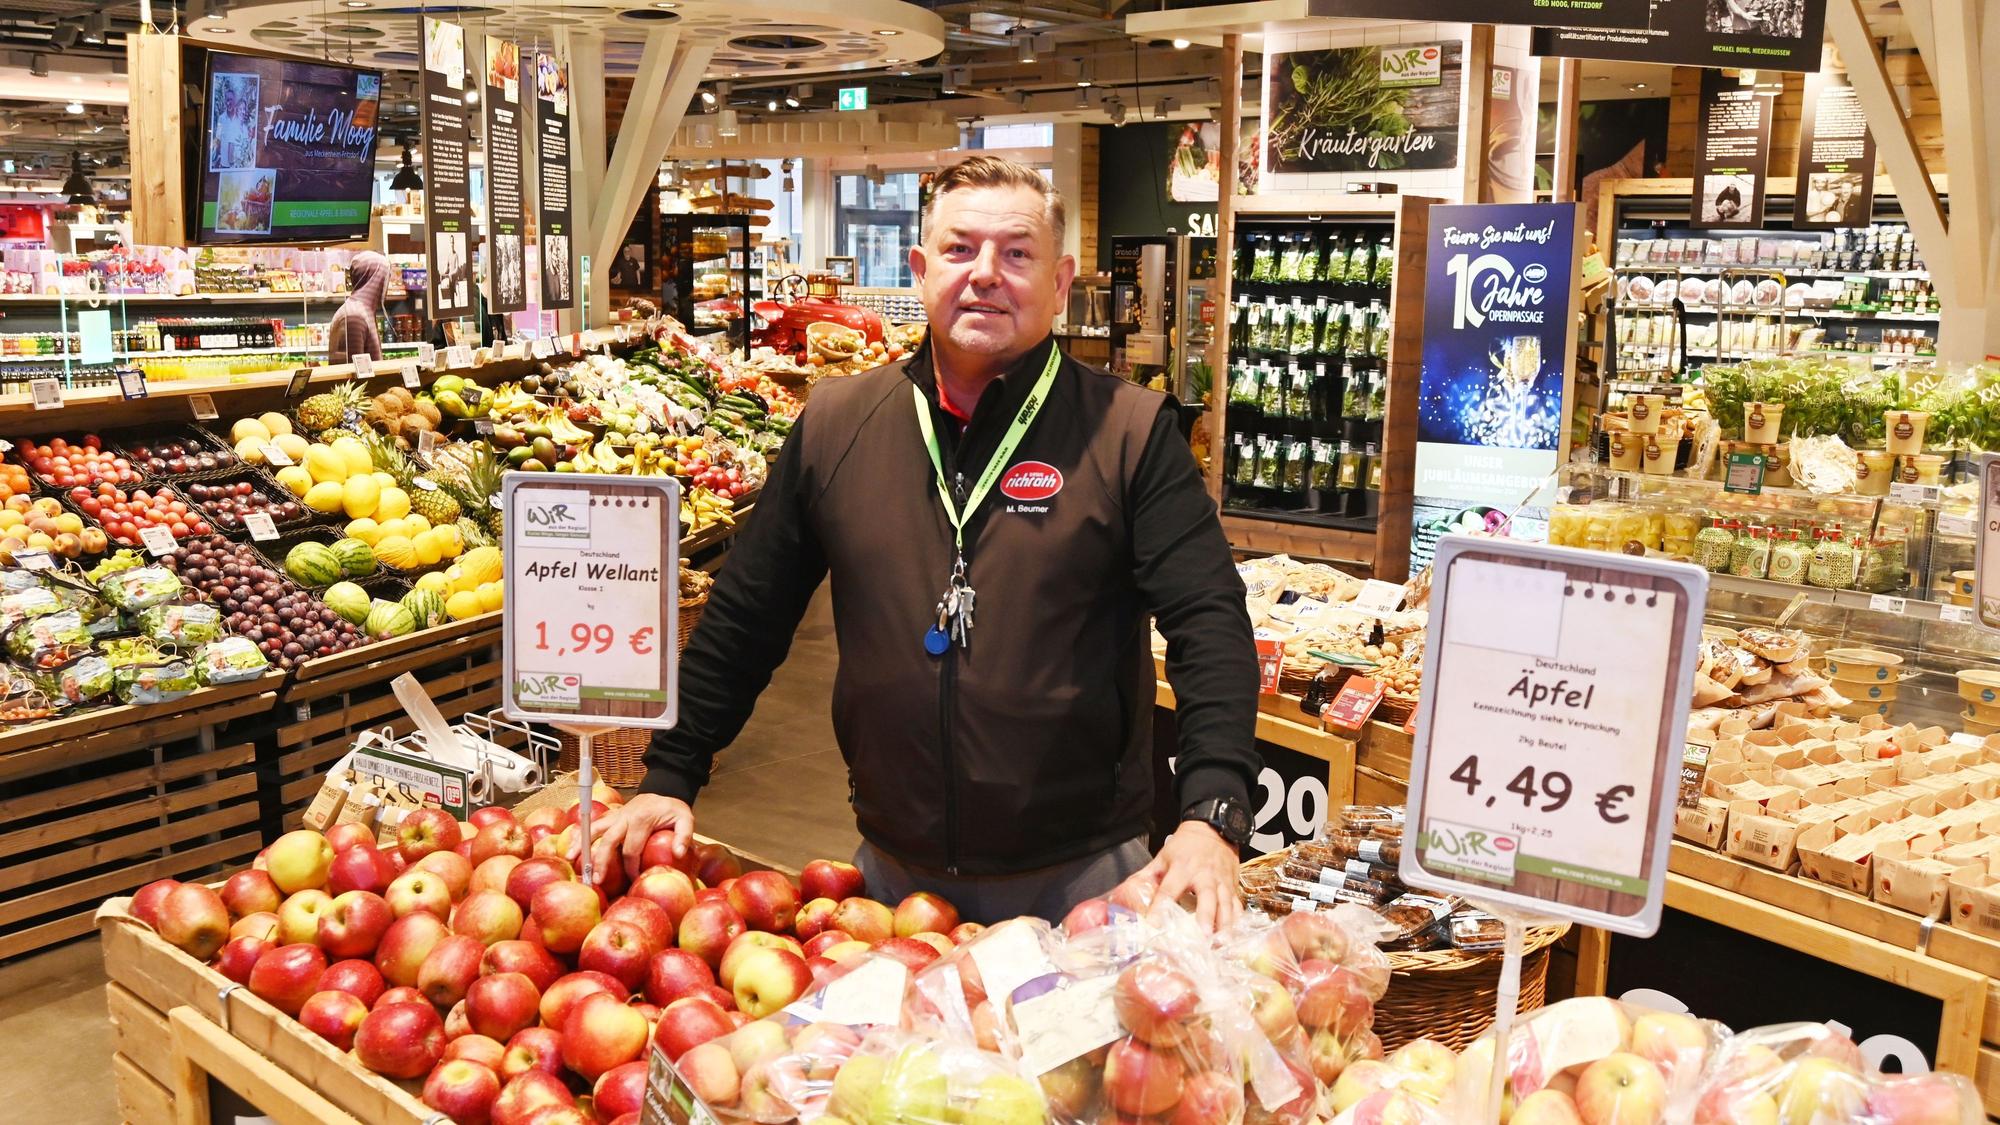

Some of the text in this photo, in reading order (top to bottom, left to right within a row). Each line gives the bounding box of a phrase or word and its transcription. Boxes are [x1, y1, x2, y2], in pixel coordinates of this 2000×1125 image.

[1712, 45, 1735, 53] MICHAEL
[1383, 49, 1428, 74] WiR
[263, 104, 325, 146] Familie
[328, 107, 376, 164] Moog
[1298, 125, 1436, 169] Kräutergarten
[1443, 226, 1480, 248] Feiern
[1480, 225, 1502, 250] Sie
[1502, 222, 1525, 243] mit
[1446, 253, 1516, 330] 10
[1481, 273, 1545, 313] Jahre
[1488, 309, 1544, 324] OPERNPASSAGE
[1908, 375, 1938, 400] XXL
[1464, 455, 1504, 470] UNSER
[1006, 472, 1057, 488] richrath
[527, 504, 576, 526] WiR
[1018, 504, 1049, 513] Beumer
[580, 550, 620, 559] Deutschland
[525, 560, 659, 582] Apfel Wellant
[536, 621, 654, 656] 1,99 €
[1535, 658, 1596, 676] Deutschland
[521, 676, 567, 695] WiR
[1507, 668, 1595, 709] Äpfel
[1473, 701, 1621, 736] Kennzeichnung siehe Verpackung
[1518, 735, 1567, 751] 2kg Beutel
[1450, 754, 1635, 823] 4,49 €
[1431, 828, 1497, 857] WiR
[1471, 859, 1483, 867] der
